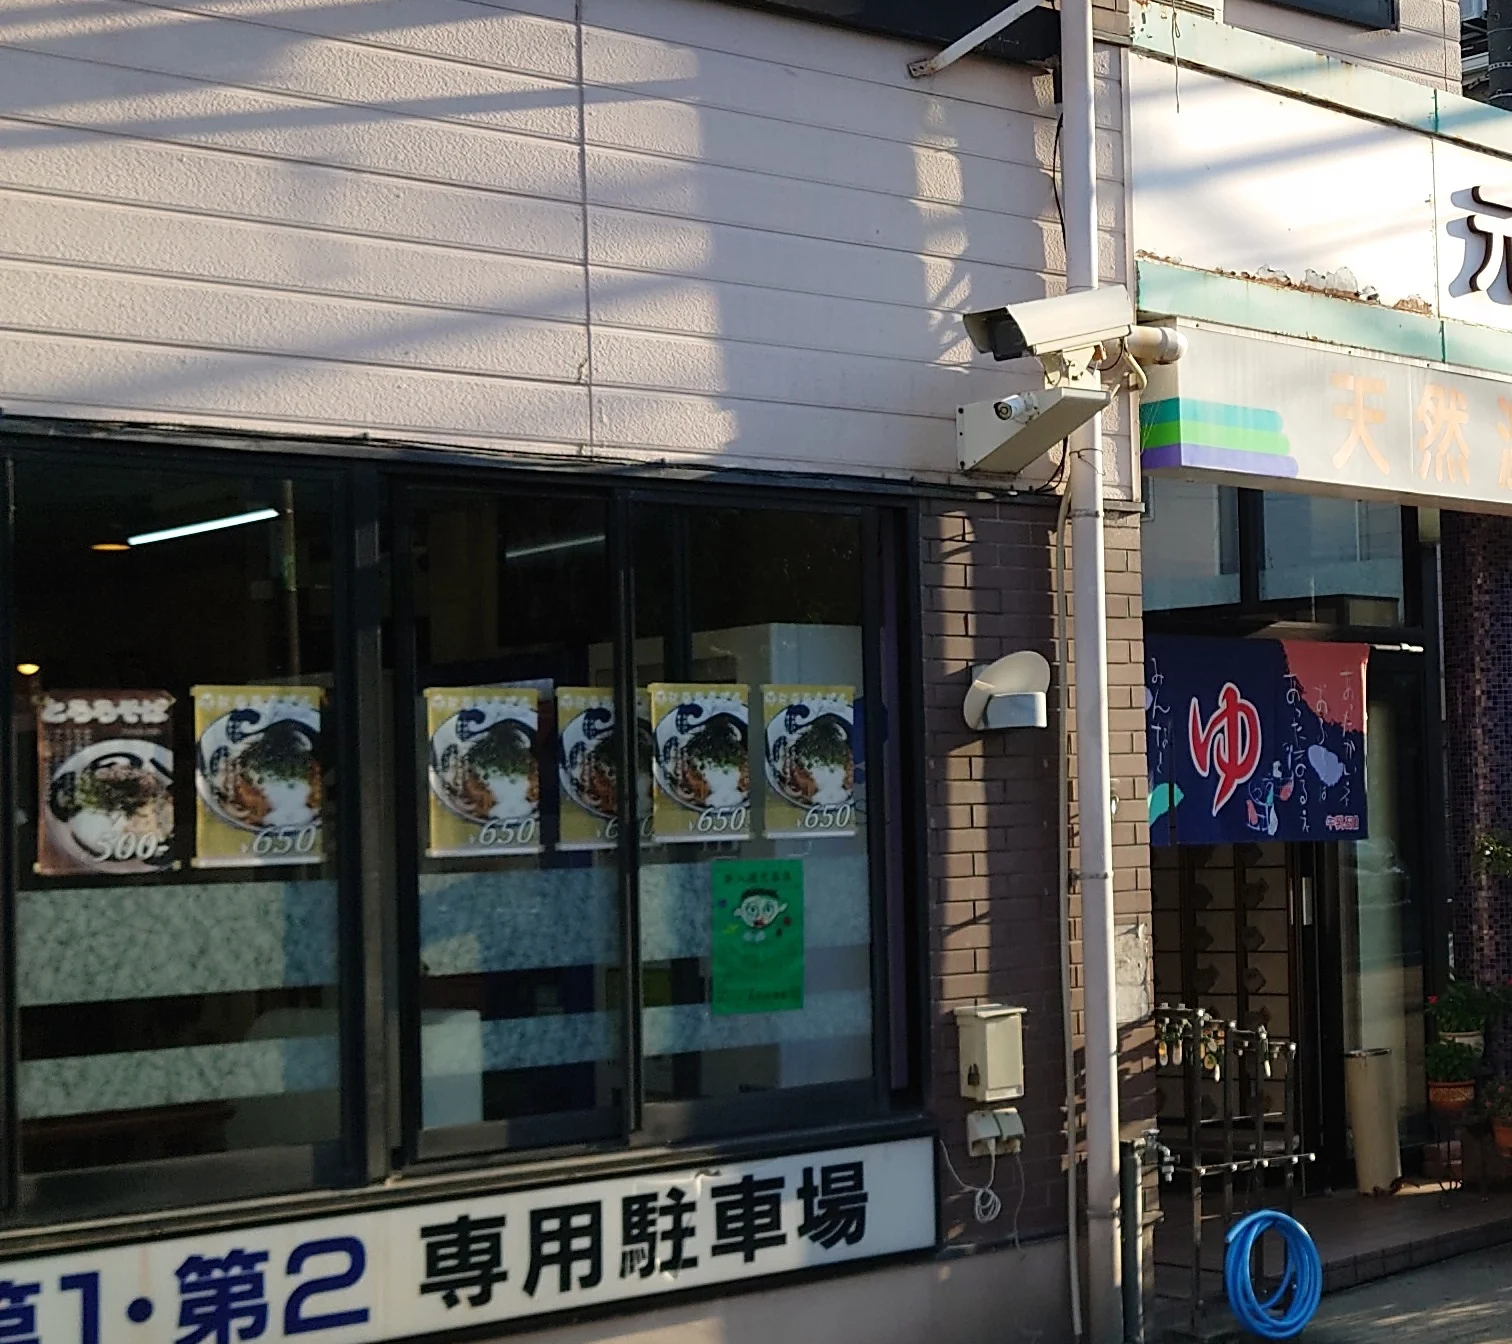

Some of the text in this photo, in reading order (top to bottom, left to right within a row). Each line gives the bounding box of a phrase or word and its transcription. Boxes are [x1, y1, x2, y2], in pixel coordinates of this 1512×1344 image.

[1188, 681, 1263, 818] ゆ
[421, 1160, 870, 1310] 専用駐車場
